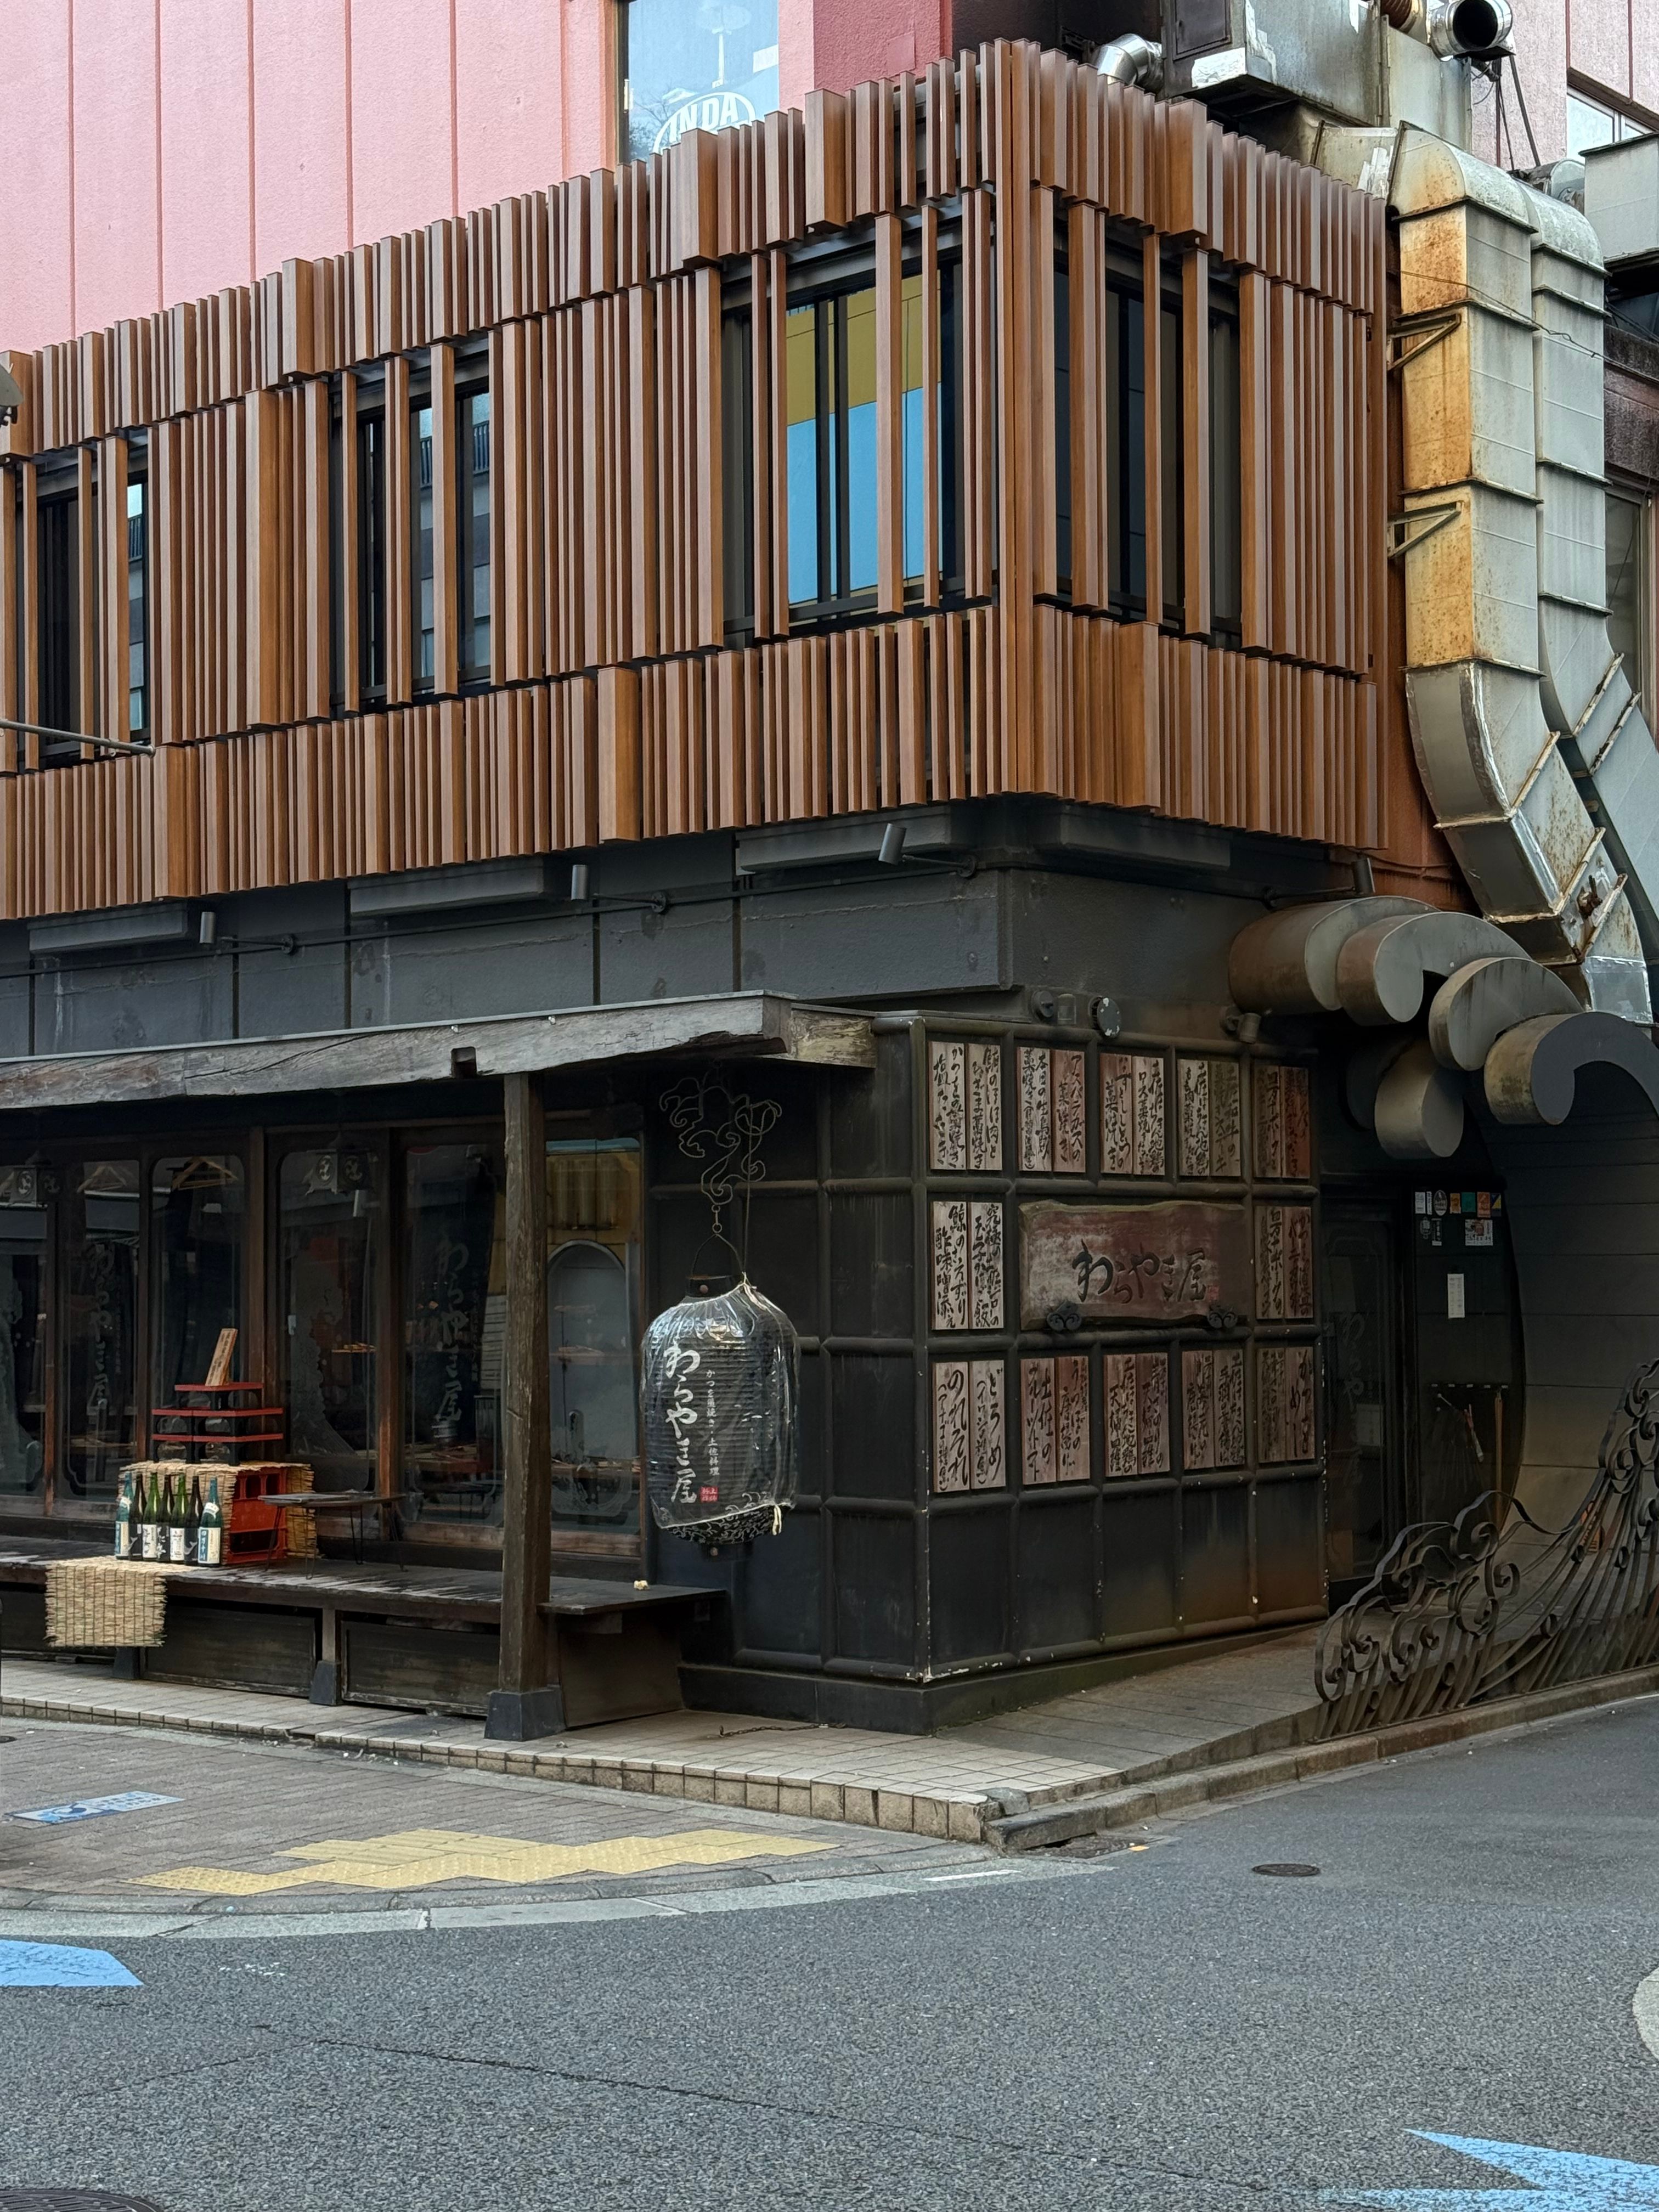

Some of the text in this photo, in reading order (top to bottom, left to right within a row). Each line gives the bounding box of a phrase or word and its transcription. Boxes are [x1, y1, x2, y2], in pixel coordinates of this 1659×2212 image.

[1070, 1054, 1085, 1163] アスパラガスの
[1071, 1238, 1207, 1304] わらやき屋
[663, 1341, 701, 1504] わらやき屋
[947, 1369, 968, 1487] のれそれ
[988, 1367, 1003, 1481] どろめ
